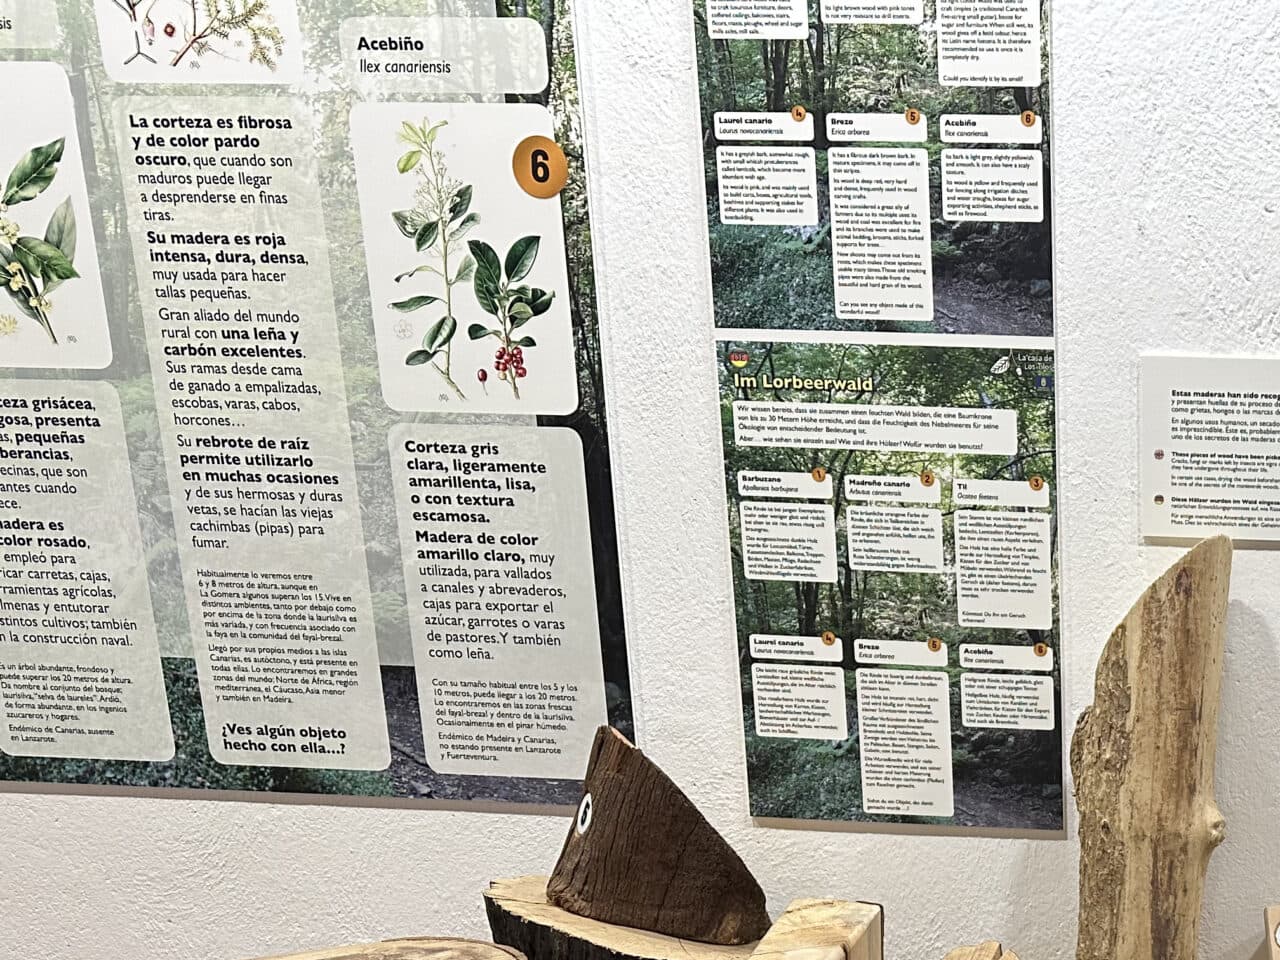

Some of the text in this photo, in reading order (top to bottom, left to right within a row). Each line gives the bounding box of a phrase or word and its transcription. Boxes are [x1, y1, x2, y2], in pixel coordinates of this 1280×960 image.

[357, 36, 423, 50] Acebiño
[384, 60, 450, 73] canariensis
[795, 108, 802, 116] 4
[910, 111, 915, 121] 5
[1025, 113, 1030, 122] 6
[129, 114, 292, 129] La corteza es fibrosa
[131, 133, 259, 151] y de color pardo
[135, 155, 190, 166] oscuro,
[531, 149, 549, 182] 6
[147, 230, 286, 249] Su madera es roja
[149, 248, 308, 265] intensa, dura, densa,
[734, 373, 874, 392] Im Lorbeerwald
[404, 440, 498, 458] Corteza gris
[406, 457, 546, 475] clara, ligeramente
[924, 474, 929, 483] 2
[1033, 478, 1039, 487] 3
[222, 723, 346, 741] ¿Ves algún objeto
[223, 738, 266, 751] hecho
[270, 743, 296, 752] con
